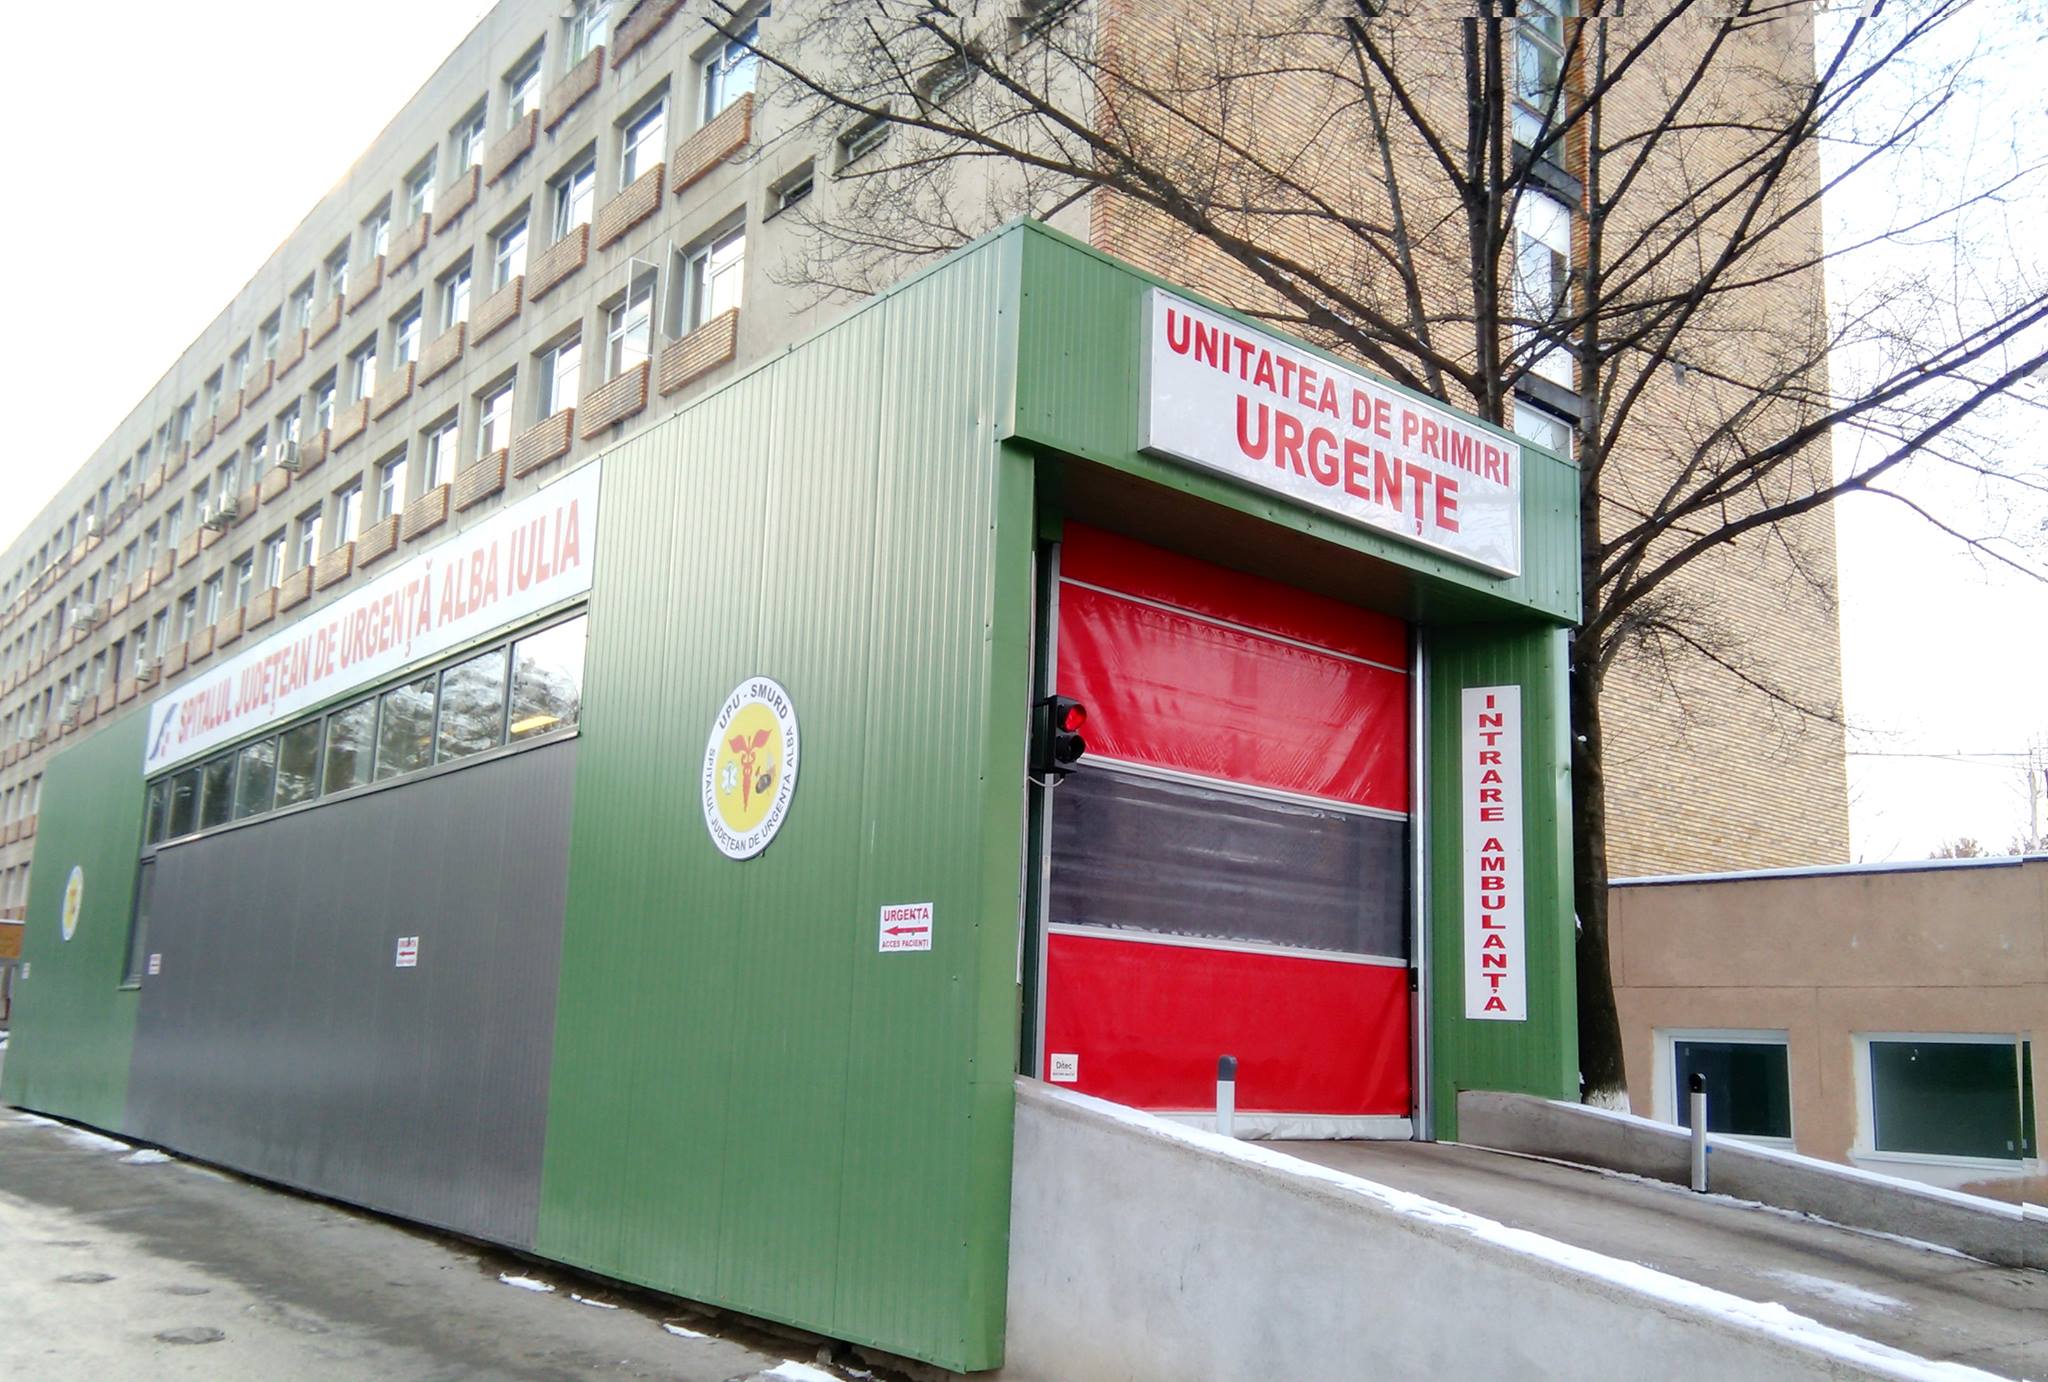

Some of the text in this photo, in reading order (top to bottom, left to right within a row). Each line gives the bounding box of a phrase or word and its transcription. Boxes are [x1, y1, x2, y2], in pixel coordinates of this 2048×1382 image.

[1167, 307, 1510, 487] UNITATEA DE PRIMIRI
[1236, 395, 1460, 536] URGENȚE
[178, 675, 232, 744] SPITALUL
[313, 617, 339, 683] DE
[438, 538, 499, 627] ALBA
[507, 499, 580, 596] IULIA
[719, 694, 741, 729] UPU
[750, 684, 788, 720] SMURD
[1479, 695, 1505, 822] INTRARE
[705, 749, 716, 815] SPITALUL
[748, 833, 761, 849] DE
[785, 726, 793, 768] ALBA
